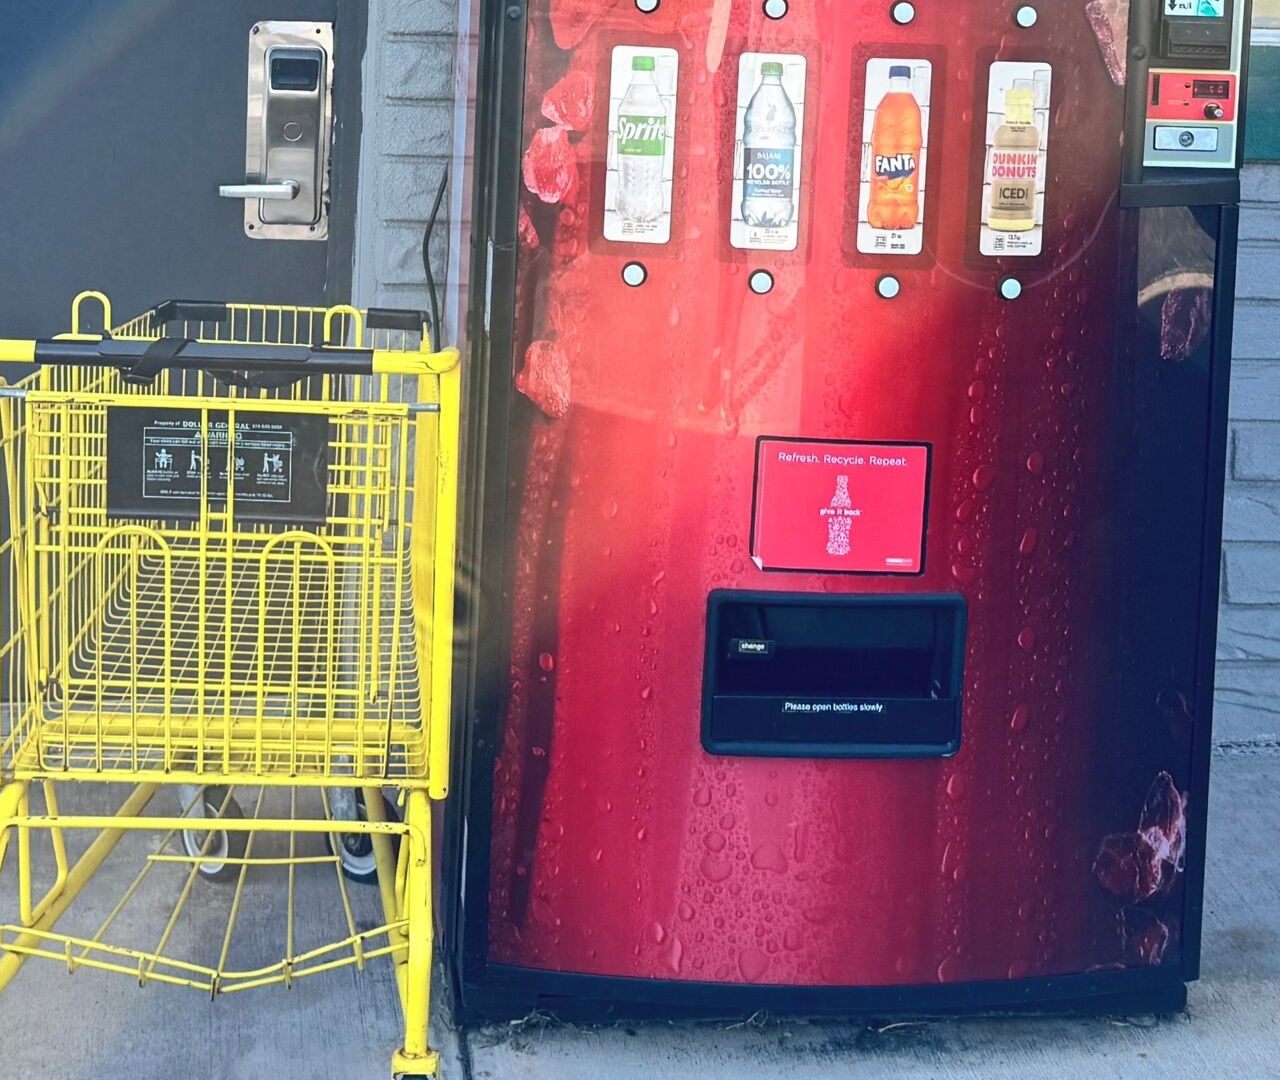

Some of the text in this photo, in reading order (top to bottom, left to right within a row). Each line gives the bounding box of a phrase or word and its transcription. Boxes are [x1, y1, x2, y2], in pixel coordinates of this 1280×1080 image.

[617, 116, 665, 145] Sprite
[746, 163, 791, 180] 100%
[875, 154, 916, 173] FANTA
[991, 165, 1037, 178] DONUTS
[778, 451, 908, 467] Refresh. Recycle. Repeat.
[784, 701, 883, 713] Please open bottles slowly
